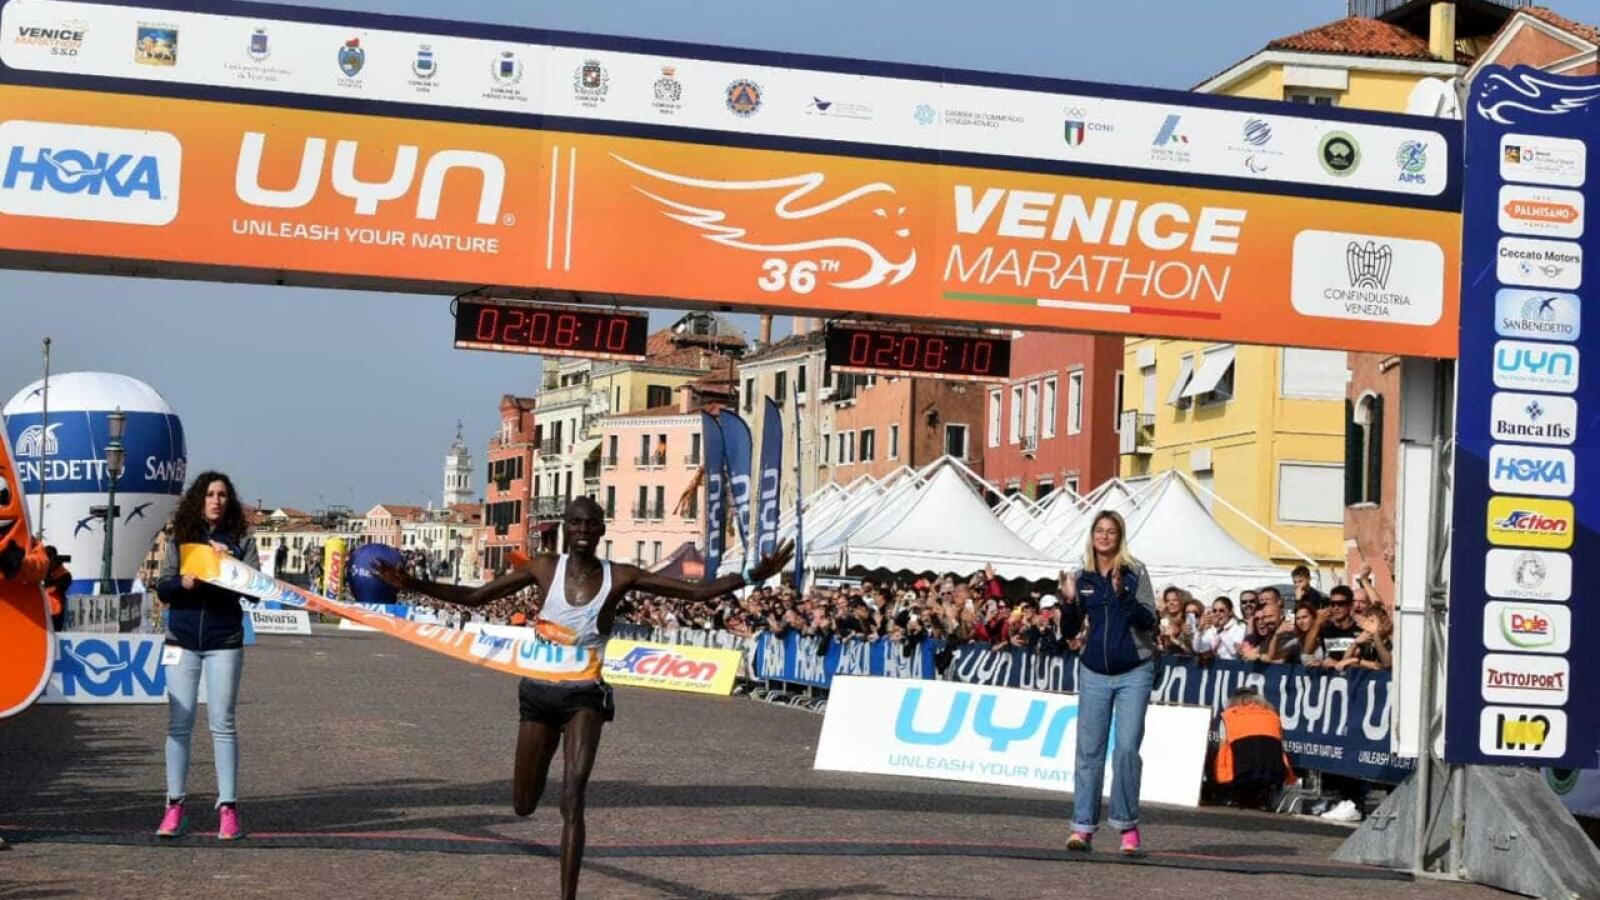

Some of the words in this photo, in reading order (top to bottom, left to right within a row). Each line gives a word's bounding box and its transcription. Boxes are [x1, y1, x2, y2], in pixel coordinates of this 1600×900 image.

[19, 26, 84, 41] VENICE
[1088, 122, 1114, 132] CONI
[2, 146, 162, 200] HOKA
[235, 132, 506, 225] UYN
[1399, 172, 1426, 185] AIMS
[953, 185, 1247, 255] VENICE
[1514, 205, 1569, 217] PALMISANO
[232, 218, 339, 242] UNLEASH
[345, 227, 405, 247] YOUR
[411, 232, 499, 254] NATURE
[1499, 247, 1542, 260] Ceccato
[1544, 251, 1580, 264] Motors
[757, 257, 840, 295] 36TH
[943, 244, 1231, 303] MARATHON
[1323, 287, 1412, 307] CONFINDUSTRIA
[1345, 301, 1390, 317] VENEZIA
[476, 309, 628, 351] 02:08:10
[850, 333, 992, 373] 02:08:10
[1497, 348, 1572, 375] UYN
[1496, 420, 1543, 437] Banca
[1547, 423, 1571, 438] Ifis
[18, 459, 126, 482] ENEDETTO
[1494, 458, 1567, 484] HOKA
[253, 611, 298, 625] Bavaria
[1512, 614, 1548, 631] Dole
[1487, 668, 1564, 689] TUTTOSPORT
[888, 754, 974, 773] UNLEASH
[979, 760, 1028, 778] YOUR
